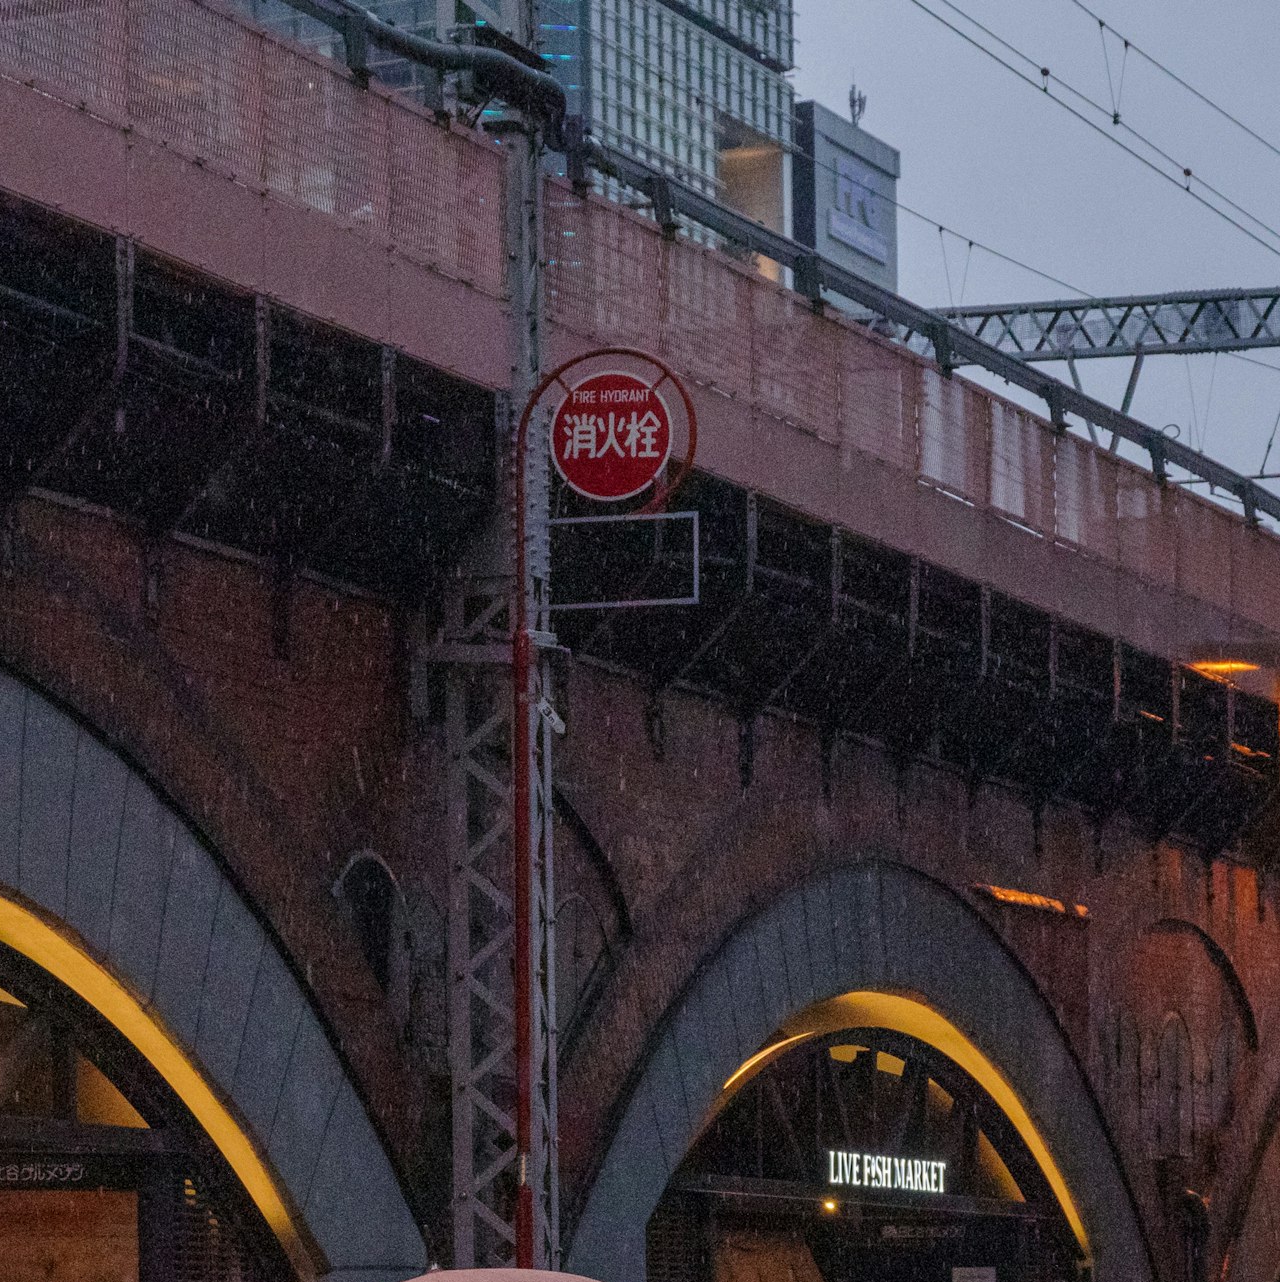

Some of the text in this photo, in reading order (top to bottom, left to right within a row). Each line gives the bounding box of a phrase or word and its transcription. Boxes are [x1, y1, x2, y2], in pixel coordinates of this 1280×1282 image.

[572, 388, 651, 405] FIRE HYDRANT
[563, 411, 662, 460] 消火栓
[829, 1150, 947, 1194] LIVE FISH MARKET
